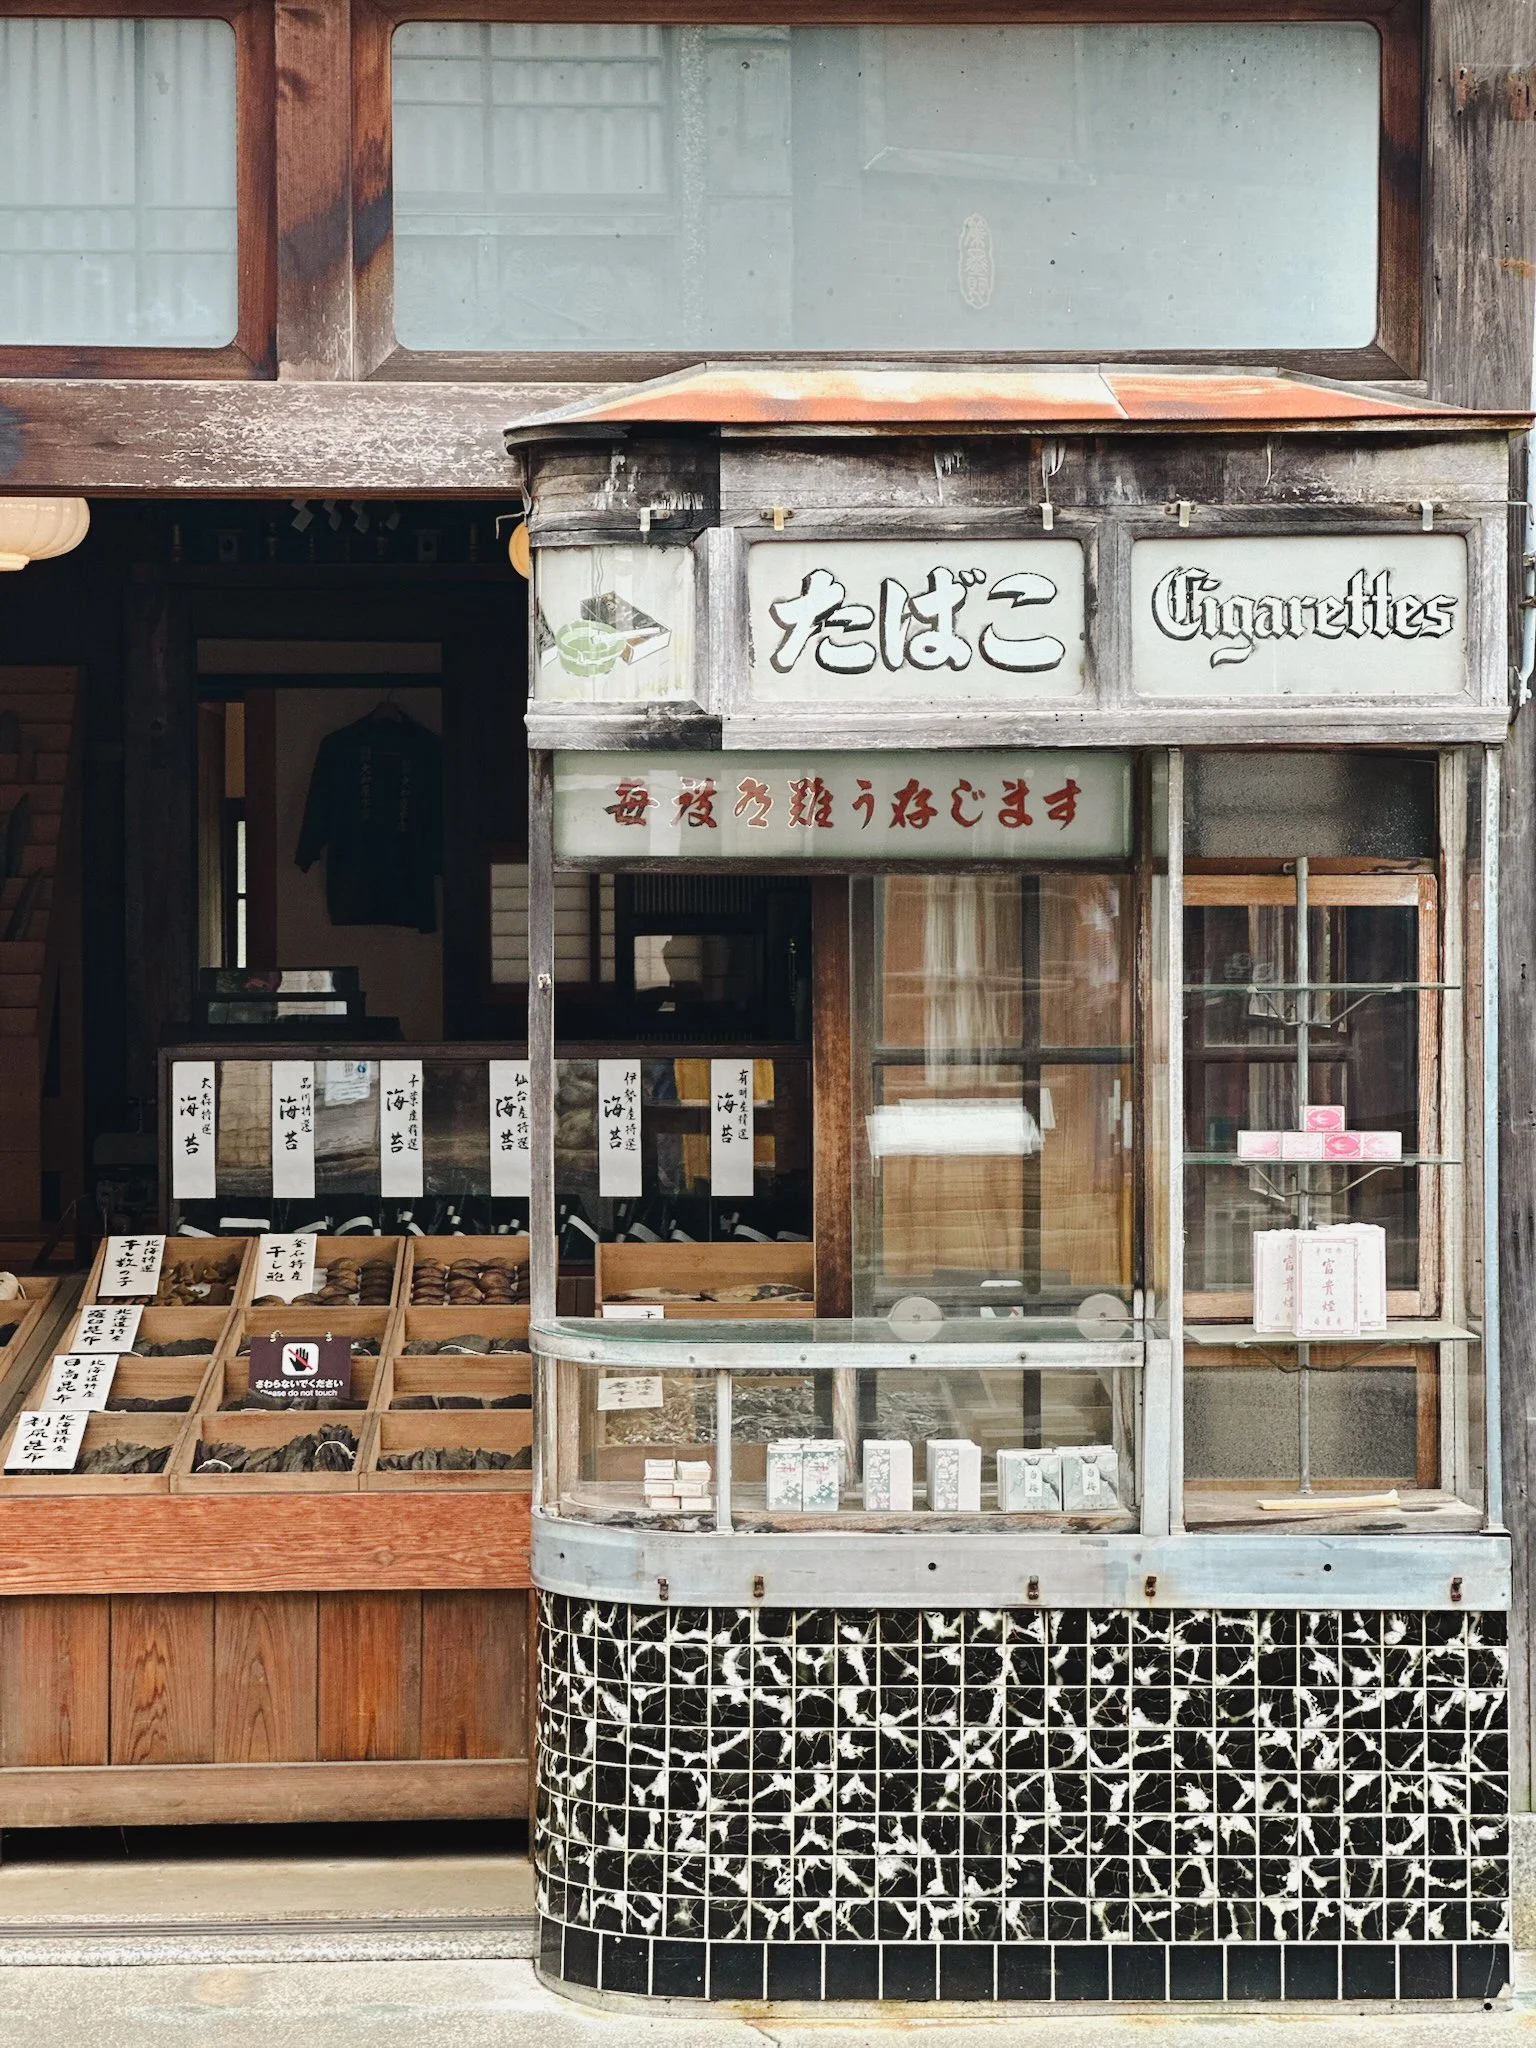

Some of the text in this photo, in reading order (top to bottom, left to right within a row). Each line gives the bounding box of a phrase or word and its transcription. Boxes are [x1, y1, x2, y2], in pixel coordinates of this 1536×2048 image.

[771, 566, 1067, 676] たばこ
[1150, 566, 1459, 669] Cigarettes
[180, 1095, 201, 1156] 海苔
[279, 1095, 301, 1151] 海苔
[299, 1076, 313, 1134] 品川特選
[386, 1087, 409, 1154] 海苔
[495, 1096, 518, 1152] 海苔
[514, 1072, 530, 1151] 仙台産特選
[603, 1094, 626, 1150] 海苔
[716, 1093, 738, 1144] 海苔
[264, 1245, 287, 1283] 干し鮑
[81, 1308, 108, 1347] 羅臼昆布
[52, 1358, 82, 1405] 日高昆布
[255, 1379, 344, 1389] さわらないでください
[287, 1389, 299, 1397] do
[299, 1389, 314, 1397] not
[314, 1389, 338, 1397] touch
[23, 1415, 52, 1464] 利尻昆布
